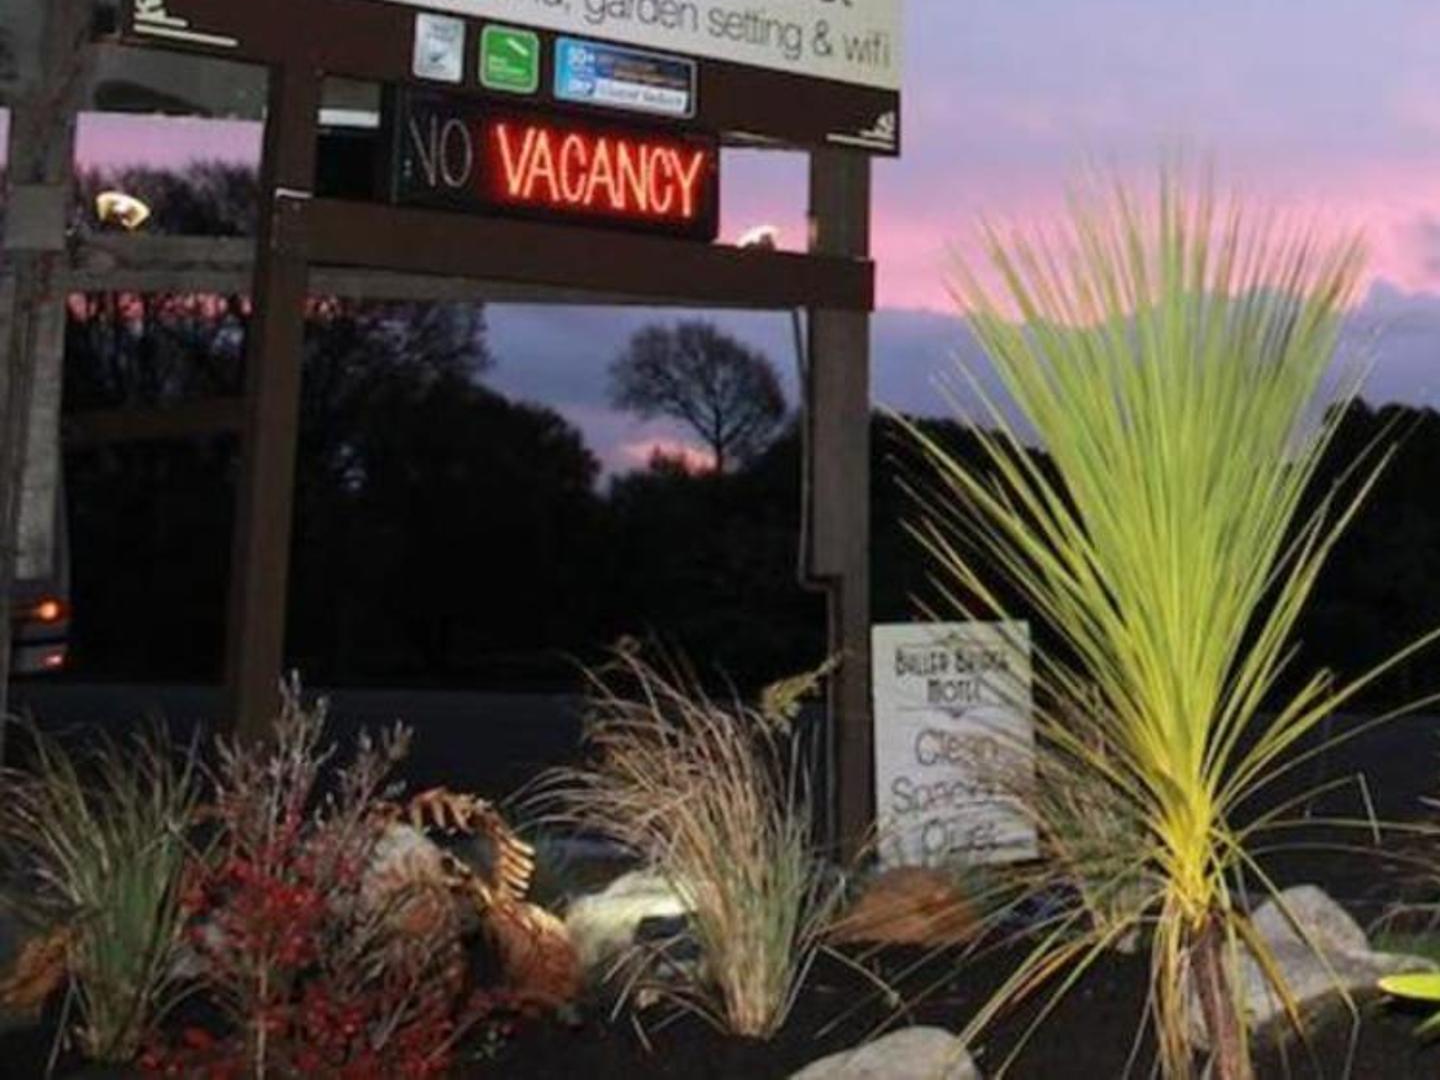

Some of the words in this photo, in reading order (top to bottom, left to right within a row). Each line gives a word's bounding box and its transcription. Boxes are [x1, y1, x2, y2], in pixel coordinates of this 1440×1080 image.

[708, 5, 801, 60] setting
[813, 19, 832, 57] &
[843, 27, 890, 68] wifi
[404, 113, 473, 188] NO
[496, 123, 704, 219] VACANCY
